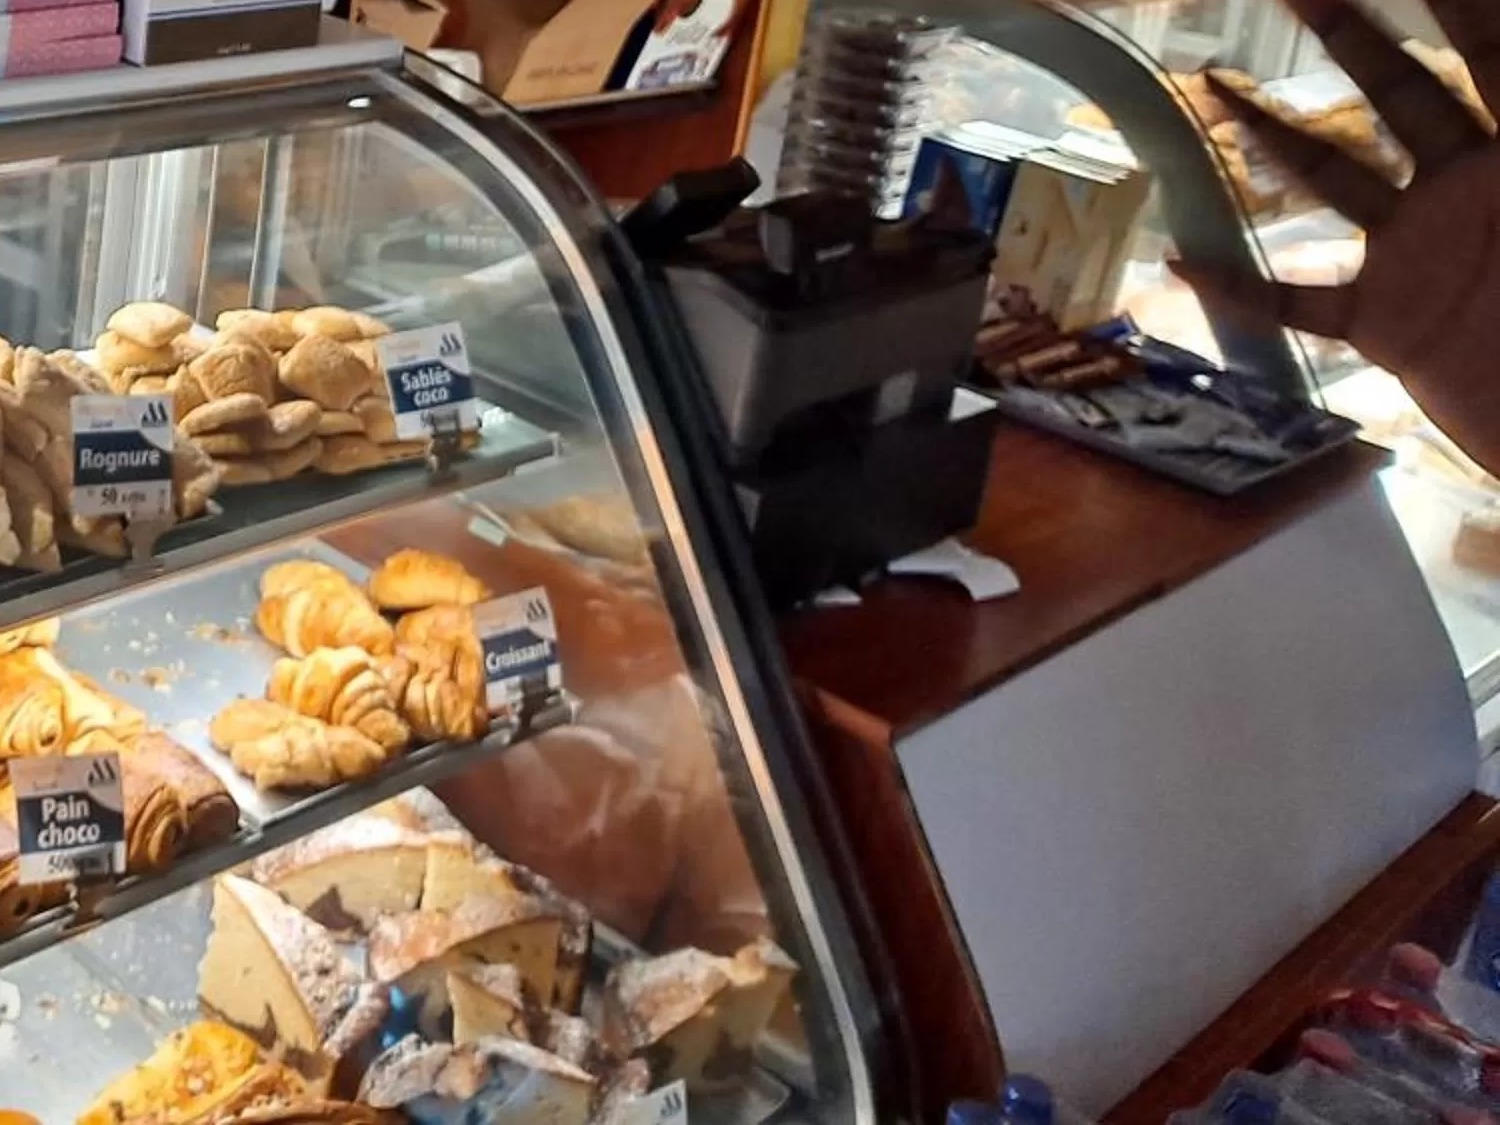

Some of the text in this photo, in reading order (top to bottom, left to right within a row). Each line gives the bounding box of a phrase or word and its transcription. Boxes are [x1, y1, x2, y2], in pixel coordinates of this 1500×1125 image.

[401, 366, 452, 392] Sablés
[414, 386, 449, 407] coco
[80, 448, 161, 473] Rognure
[41, 794, 91, 824] Pain
[37, 822, 100, 849] choco
